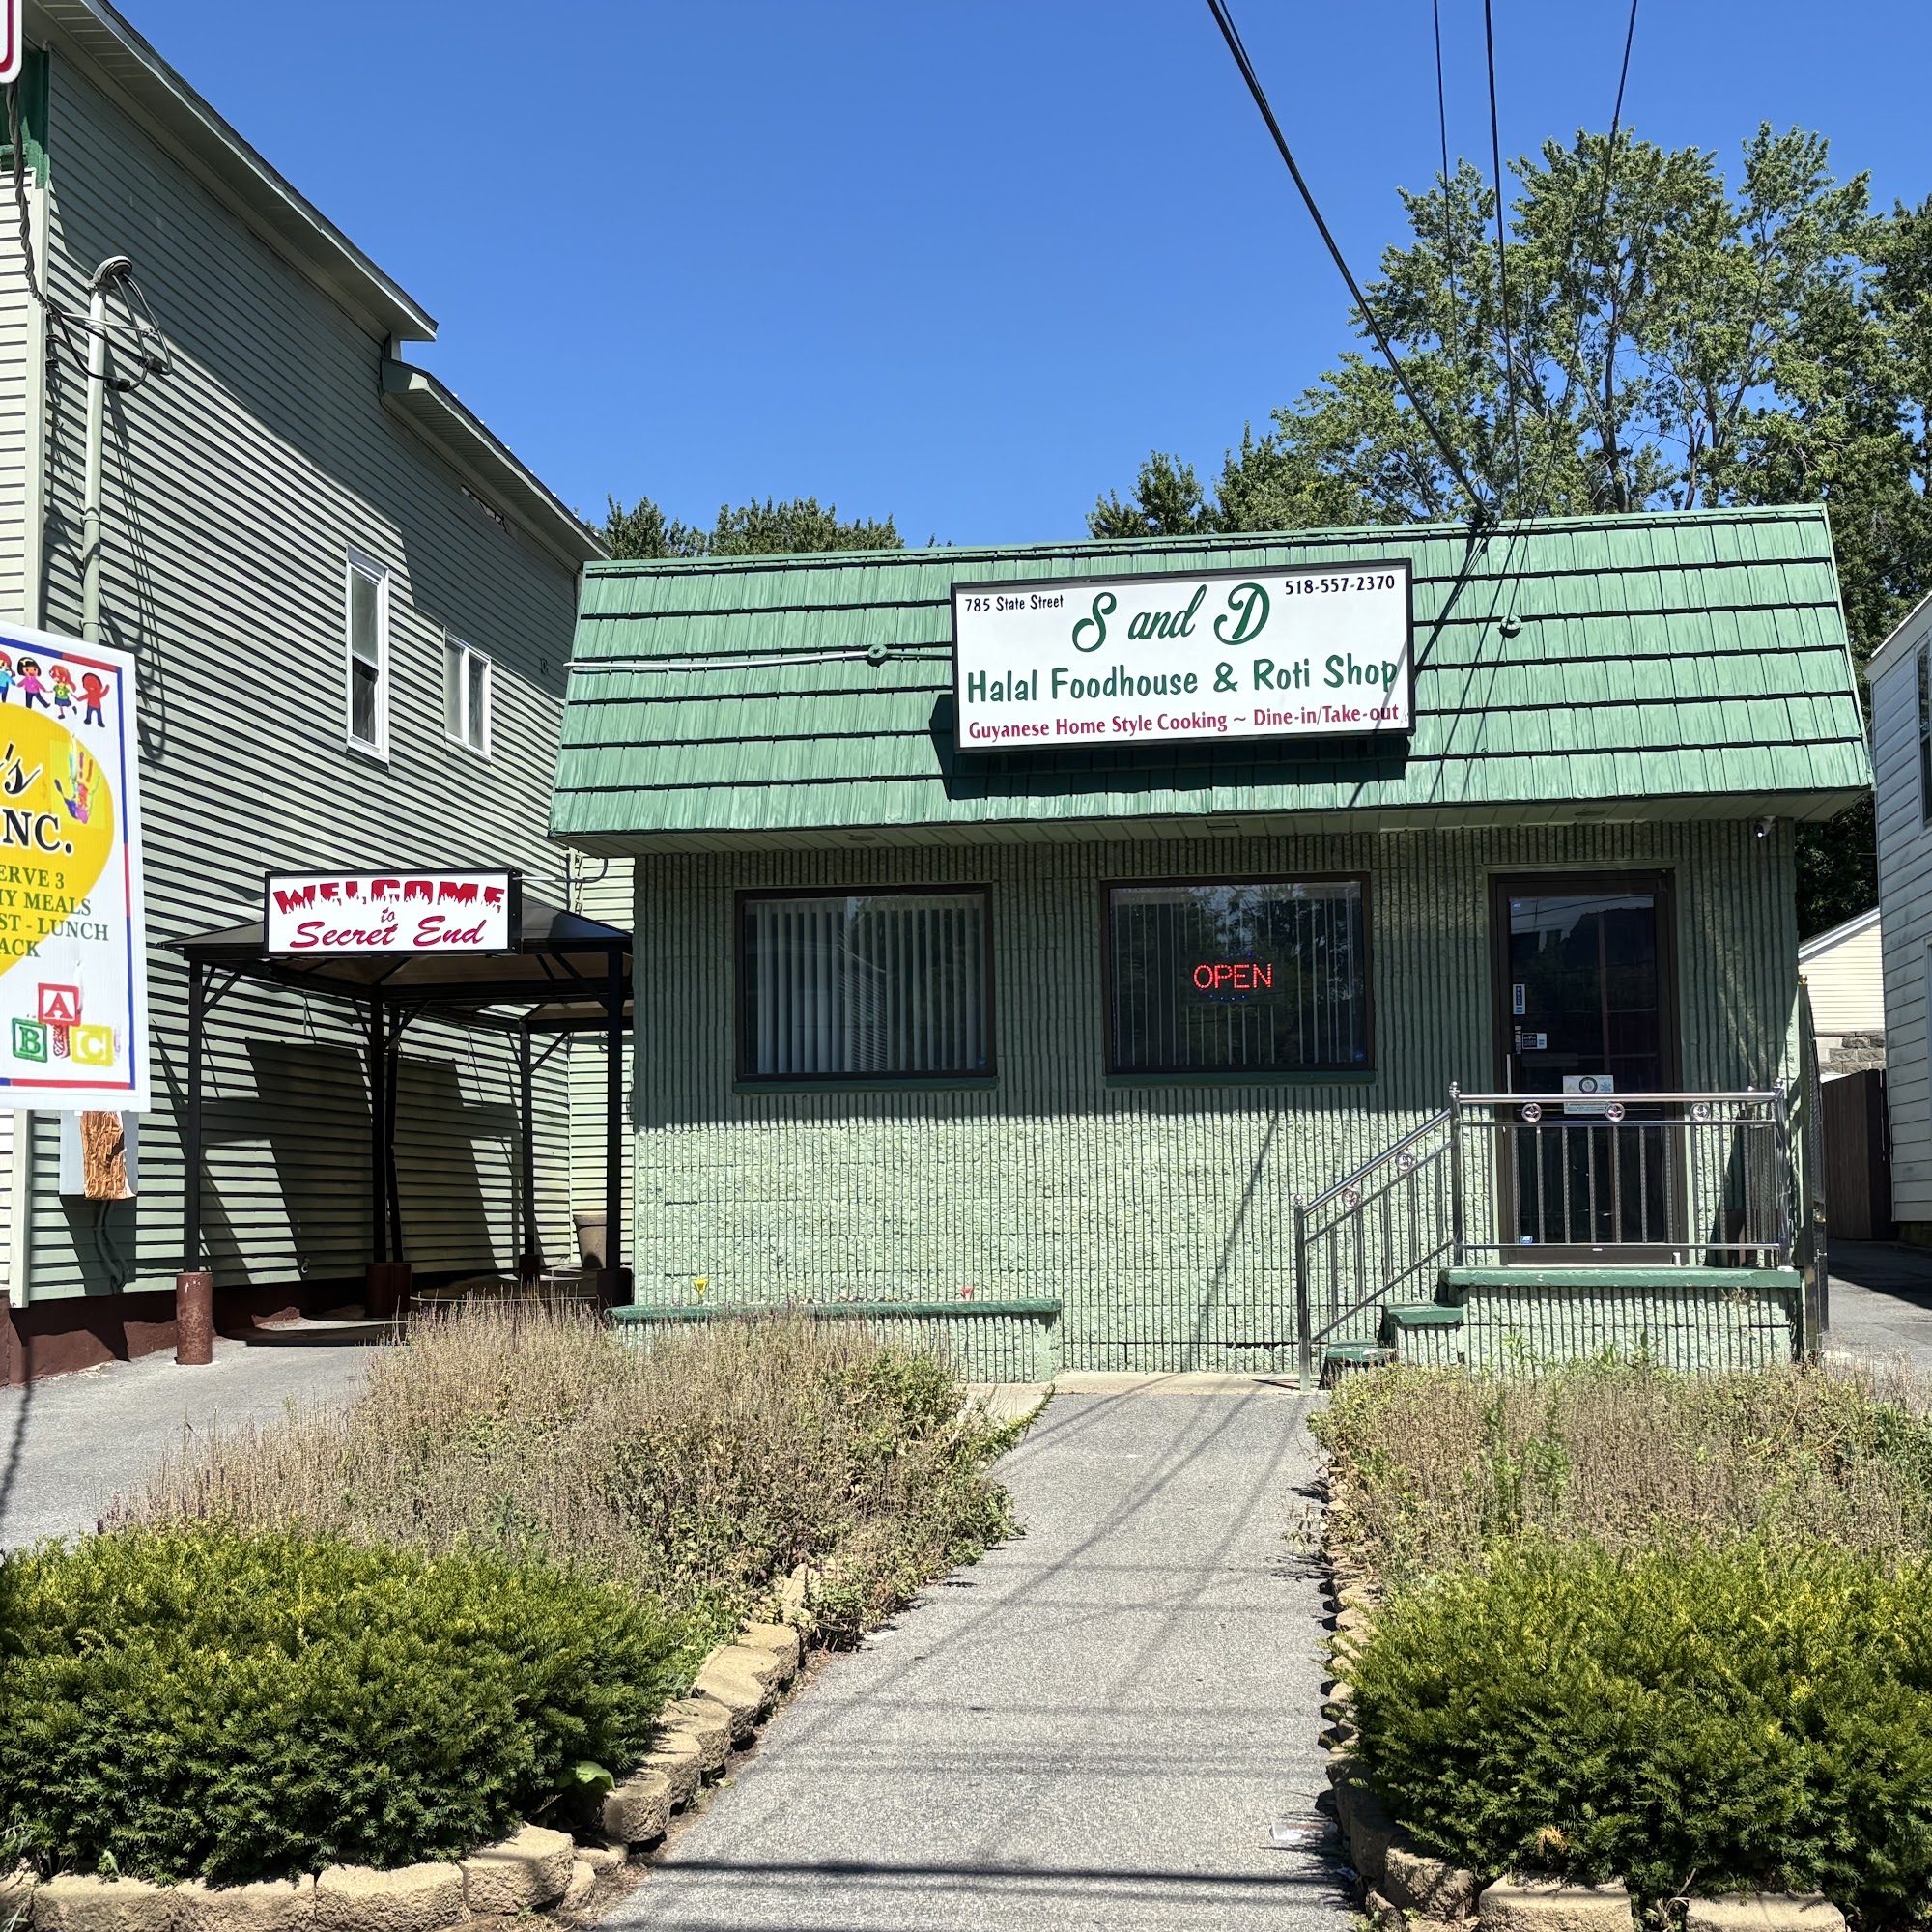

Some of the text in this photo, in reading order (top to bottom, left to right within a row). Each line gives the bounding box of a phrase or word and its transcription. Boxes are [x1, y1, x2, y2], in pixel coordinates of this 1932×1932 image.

[1285, 575, 1395, 595] 518-557-2370
[965, 594, 1064, 612] 785 State Street
[1072, 582, 1270, 653] S and D
[968, 652, 1398, 703] Halal Foodhouse & Roti Shop
[969, 721, 1050, 743] Guyanese
[1056, 718, 1106, 735] Home
[1112, 715, 1152, 737] Style
[1157, 711, 1228, 732] Cooking
[1253, 703, 1399, 726] Dine-in/Take-out
[0, 743, 41, 795] 's
[0, 808, 72, 854] NC.
[55, 871, 65, 890] 3
[23, 891, 92, 916] MEALS
[380, 907, 395, 923] to
[37, 917, 109, 942] LUNCH
[289, 915, 487, 948] Secret End
[1193, 963, 1272, 988] OPEN
[44, 991, 74, 1020] A
